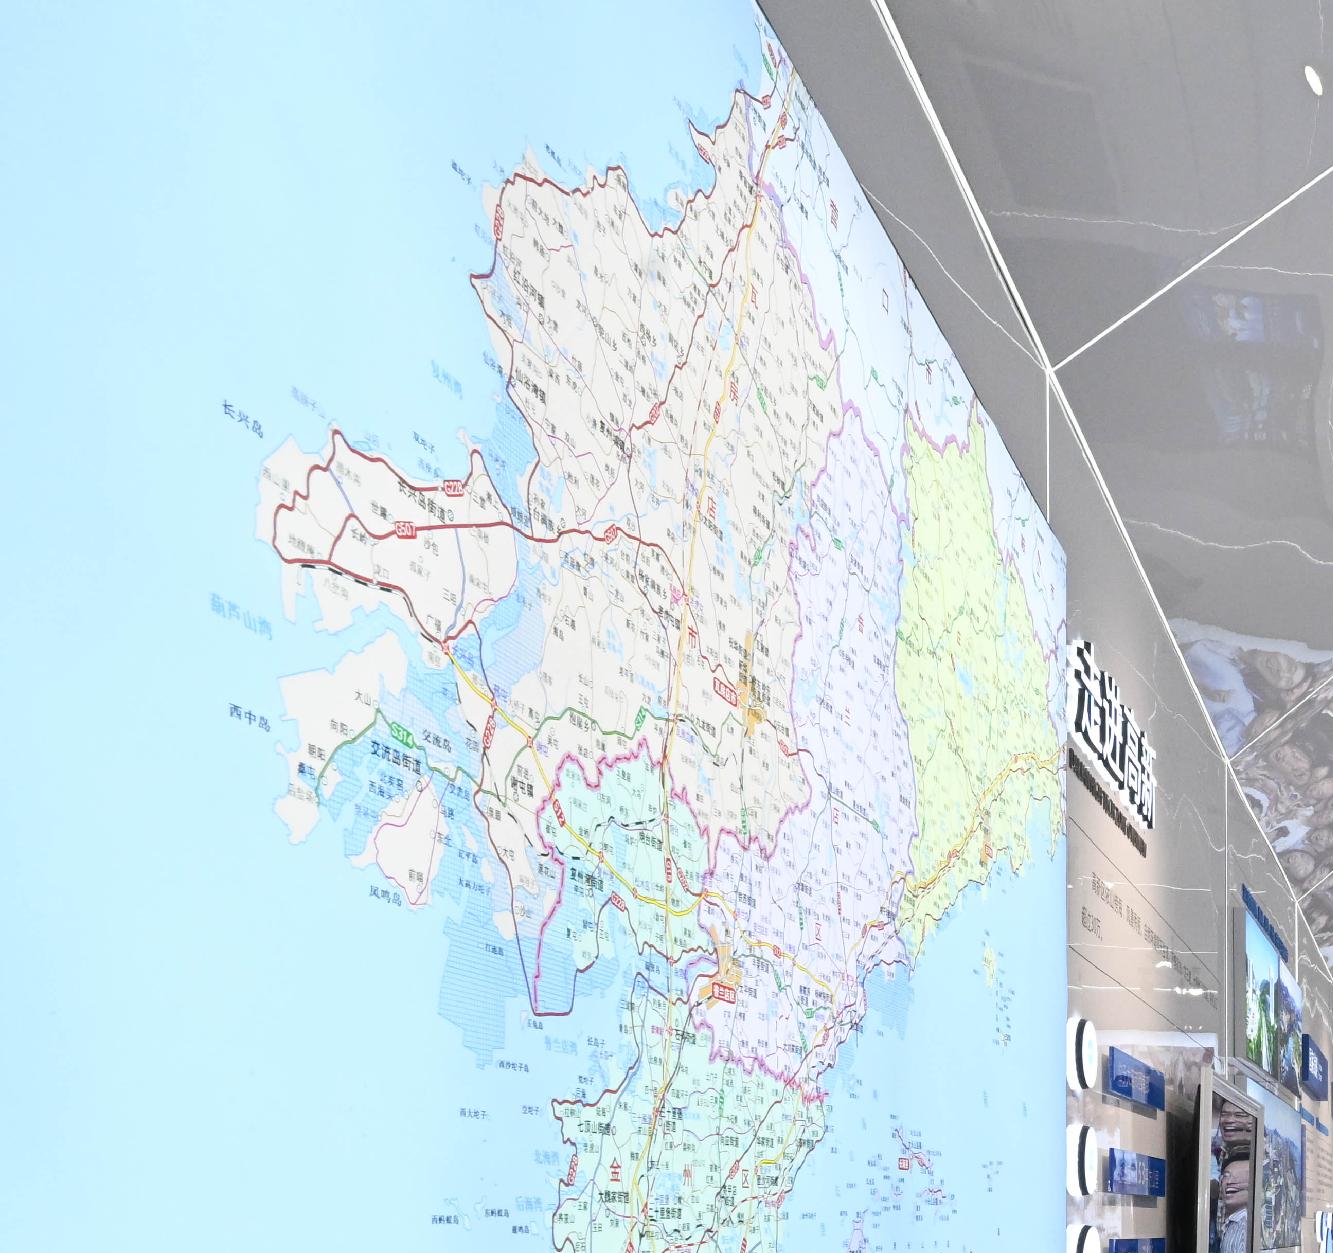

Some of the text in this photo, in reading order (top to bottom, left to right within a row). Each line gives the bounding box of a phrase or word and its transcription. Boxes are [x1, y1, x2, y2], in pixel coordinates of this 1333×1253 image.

[223, 400, 264, 438] 长兴岛
[228, 703, 270, 733] 西中岛
[1069, 640, 1155, 829] 走进高新
